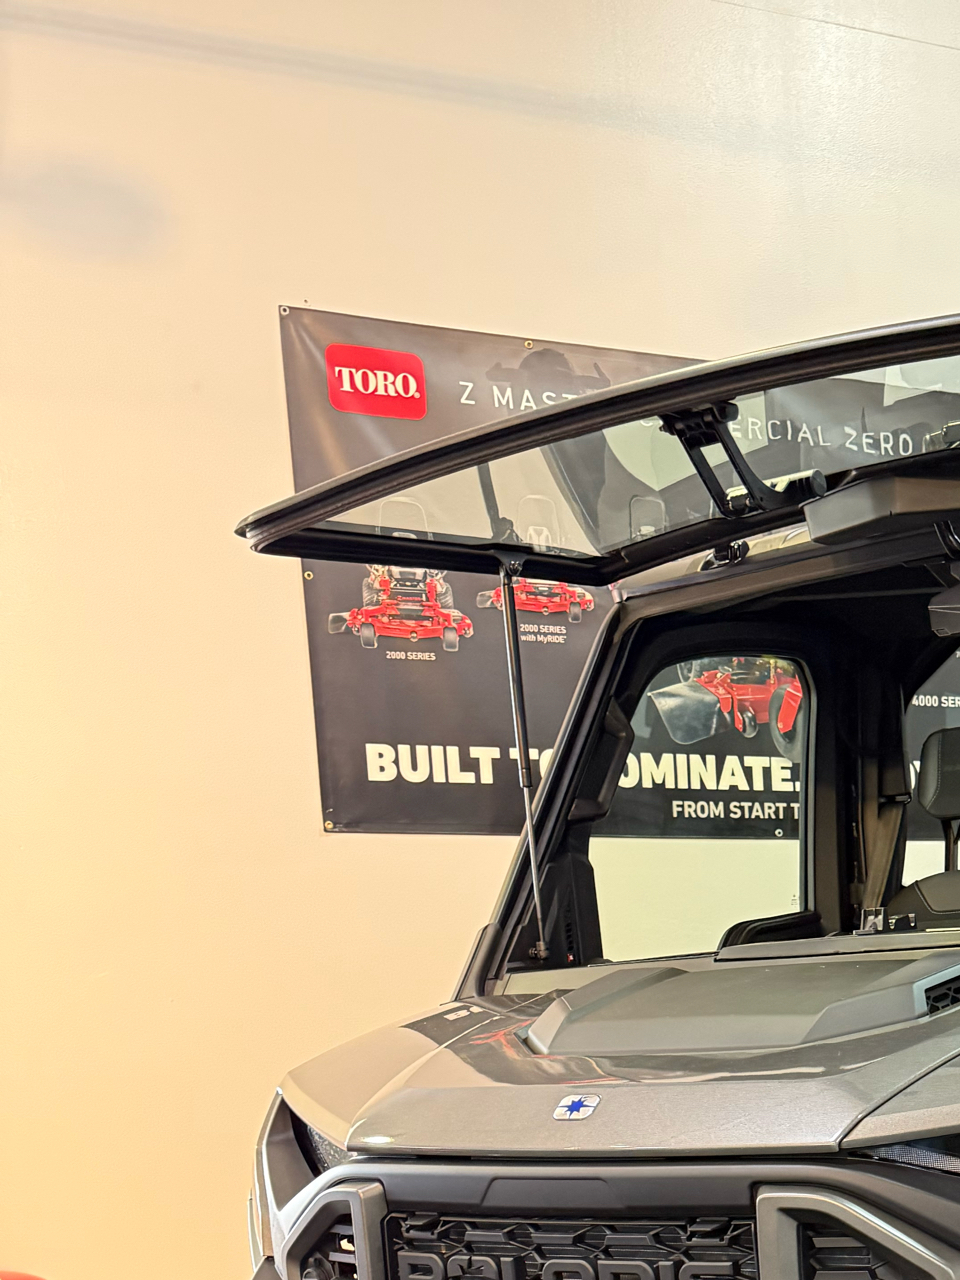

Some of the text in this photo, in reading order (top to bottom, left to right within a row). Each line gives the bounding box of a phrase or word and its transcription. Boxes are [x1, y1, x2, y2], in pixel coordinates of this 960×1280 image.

[458, 381, 476, 405] Z
[843, 426, 914, 456] ZERO
[519, 624, 567, 634] 2000 SERIES
[520, 634, 536, 642] with
[386, 651, 436, 661] 2000 SERIES
[911, 694, 939, 707] 4000
[365, 743, 501, 784] BUILT
[672, 801, 725, 819] FROM
[729, 802, 787, 819] START
